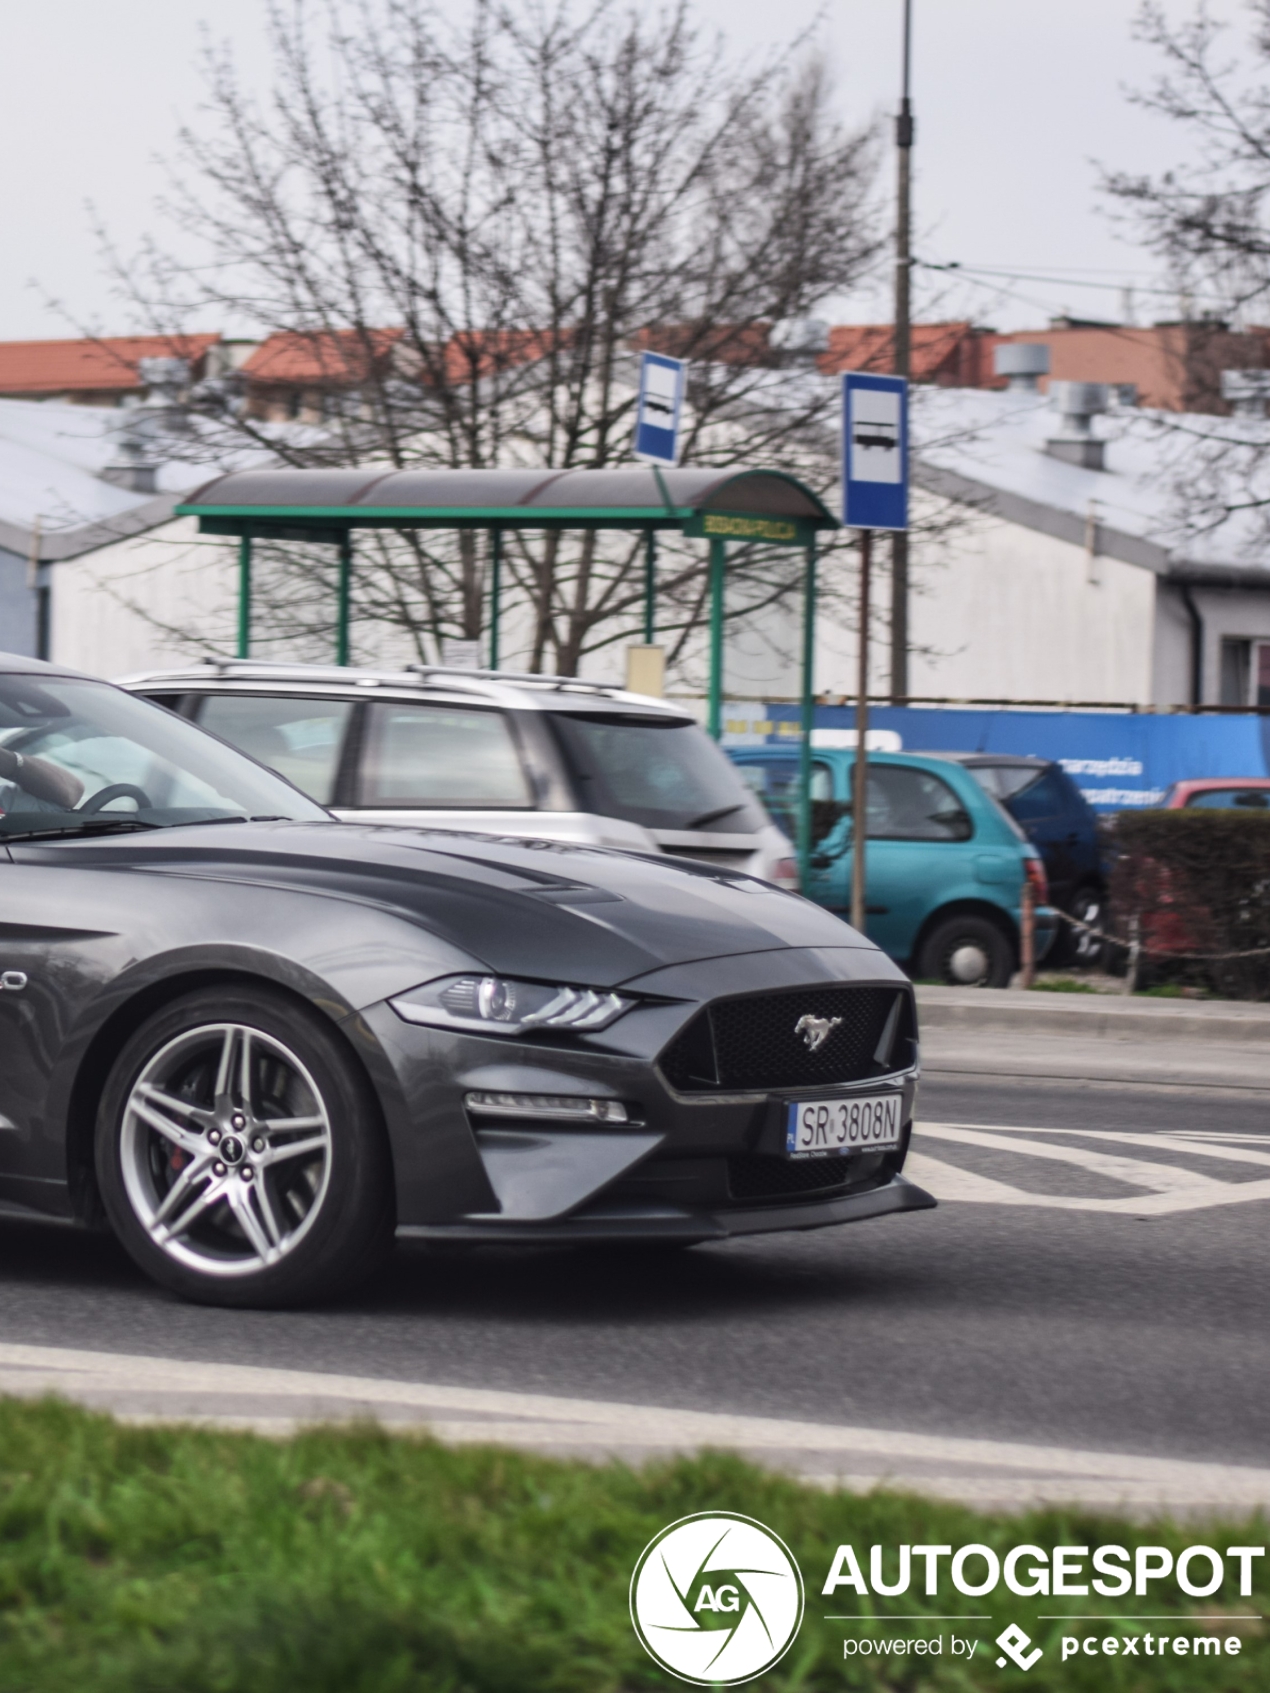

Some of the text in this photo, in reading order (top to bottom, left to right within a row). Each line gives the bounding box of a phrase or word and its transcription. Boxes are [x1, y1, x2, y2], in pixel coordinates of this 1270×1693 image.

[801, 1099, 897, 1146] SR 3808N
[786, 1132, 795, 1145] PL
